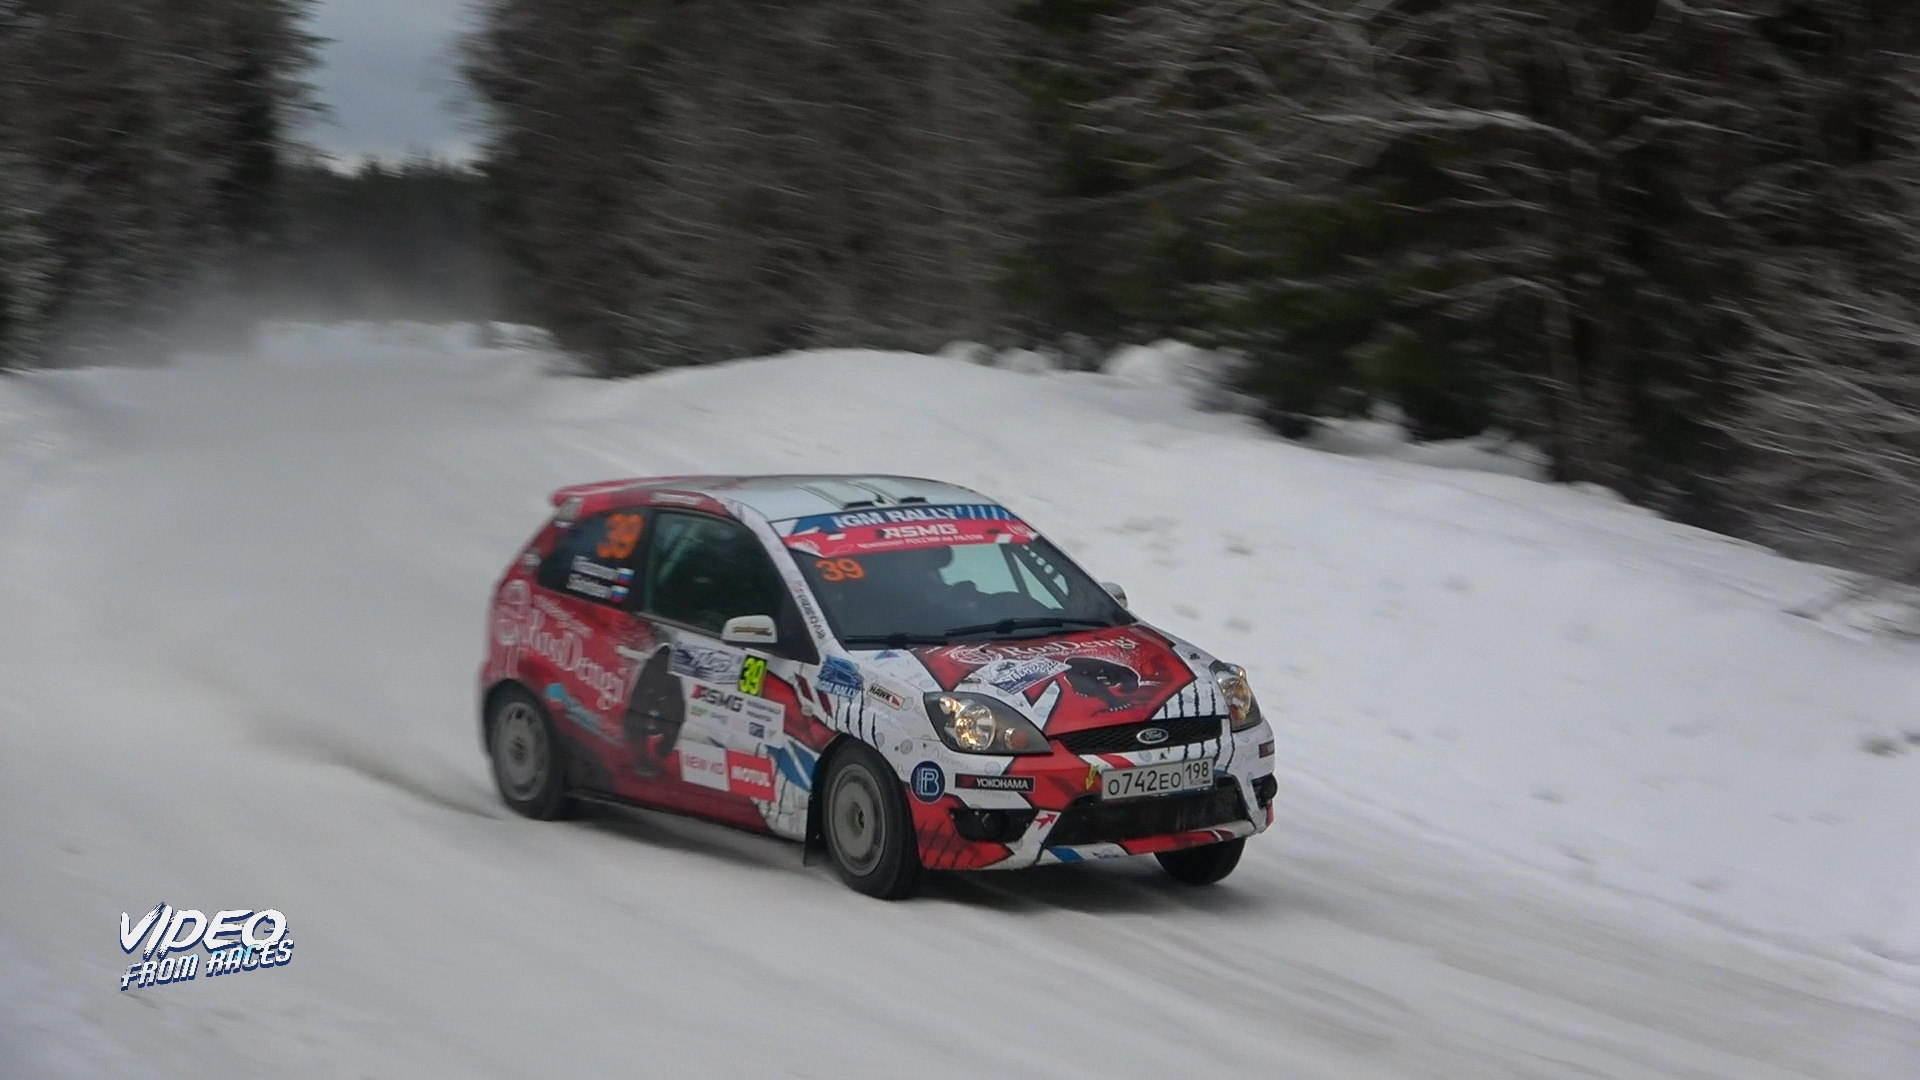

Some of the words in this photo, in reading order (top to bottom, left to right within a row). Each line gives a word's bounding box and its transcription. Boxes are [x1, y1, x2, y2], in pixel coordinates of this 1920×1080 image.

[833, 511, 885, 528] IGM
[885, 507, 956, 523] RALLY
[596, 512, 645, 559] 39
[880, 523, 959, 539] ASMG
[816, 558, 866, 583] 39
[738, 656, 766, 696] 39
[869, 685, 893, 701] HAWK
[1184, 761, 1209, 780] 198
[976, 778, 1029, 789] YOKOHAMA
